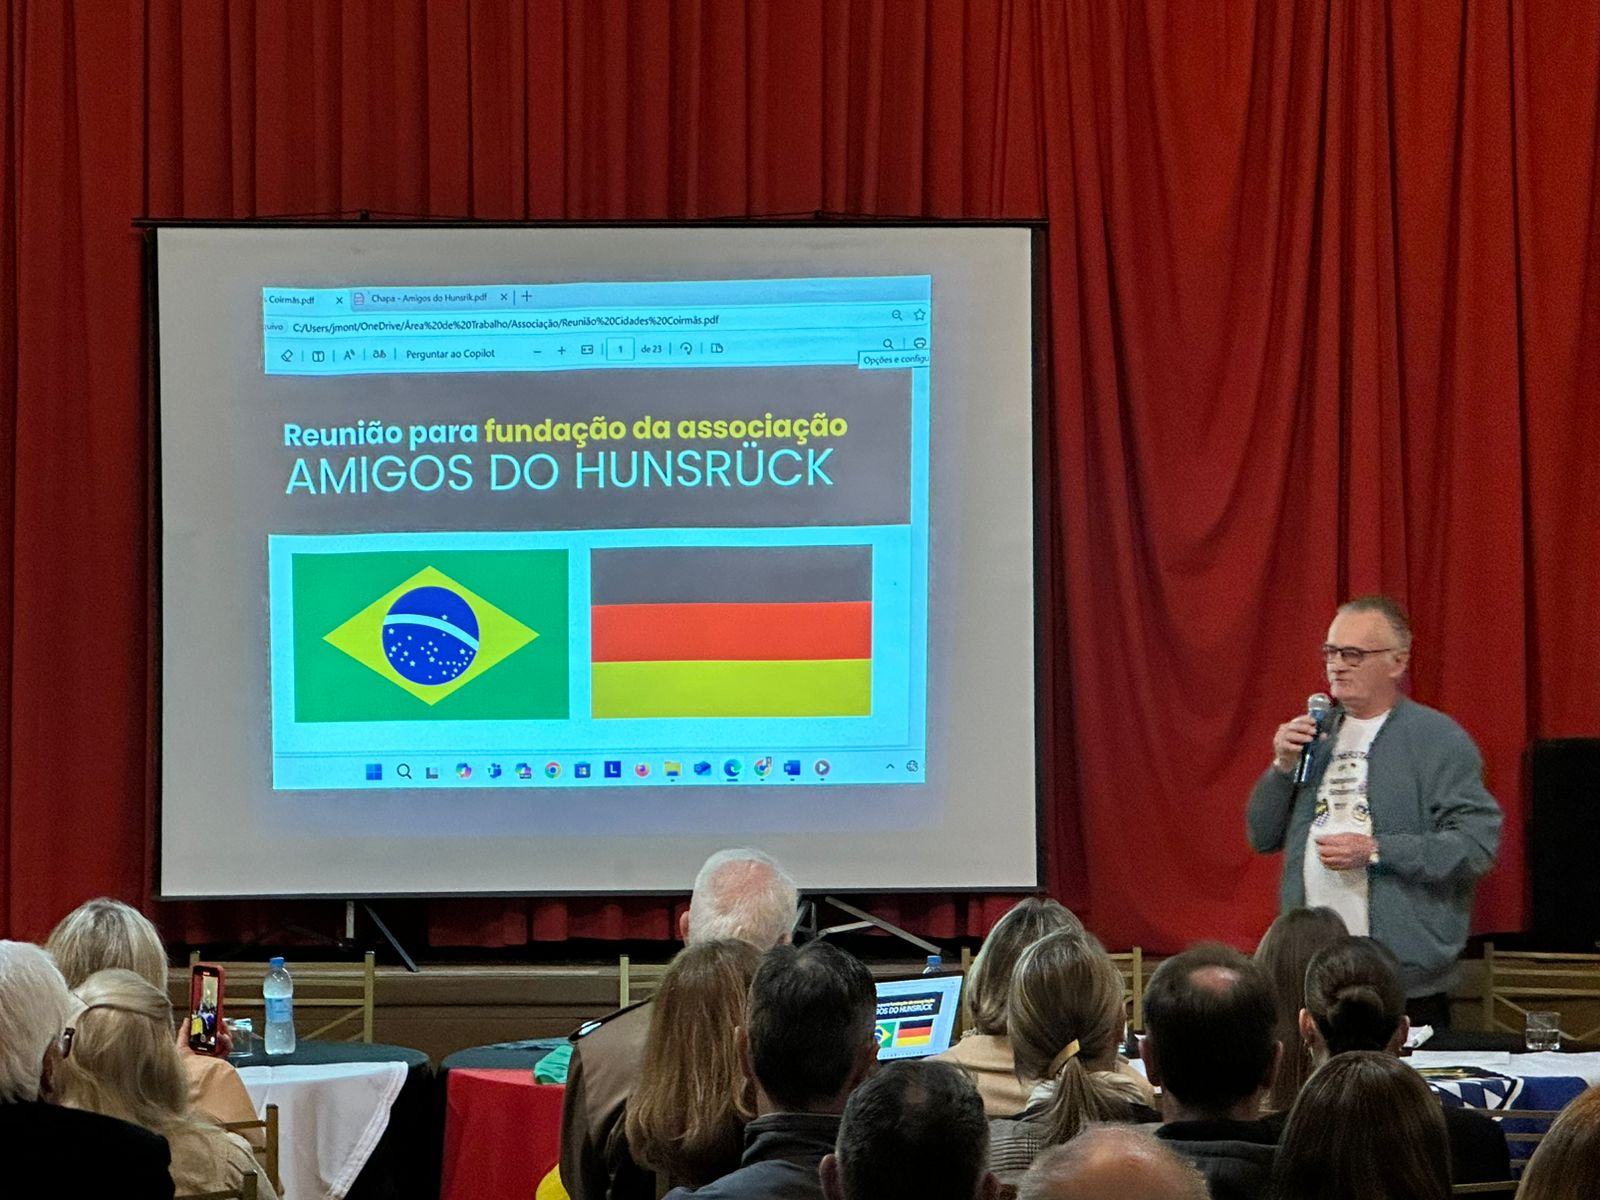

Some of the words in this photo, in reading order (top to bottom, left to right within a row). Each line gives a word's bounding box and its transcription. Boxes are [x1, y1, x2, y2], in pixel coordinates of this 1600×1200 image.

[371, 294, 396, 304] Chapa
[402, 294, 431, 304] Amigos
[432, 293, 443, 302] do
[265, 322, 284, 332] uivo
[641, 345, 651, 353] de
[652, 345, 663, 353] 23
[406, 349, 449, 361] Perguntar
[450, 351, 462, 359] ao
[463, 348, 496, 360] Copilot
[863, 356, 893, 366] Opções
[284, 420, 404, 446] Reunião
[409, 424, 478, 451] para
[484, 416, 627, 449] fundação
[632, 415, 671, 440] da
[677, 412, 848, 446] associação
[285, 453, 474, 495] AMIGOS
[490, 452, 560, 492] DO
[576, 440, 834, 490] HUNSRÜCK
[889, 1006, 899, 1015] DO
